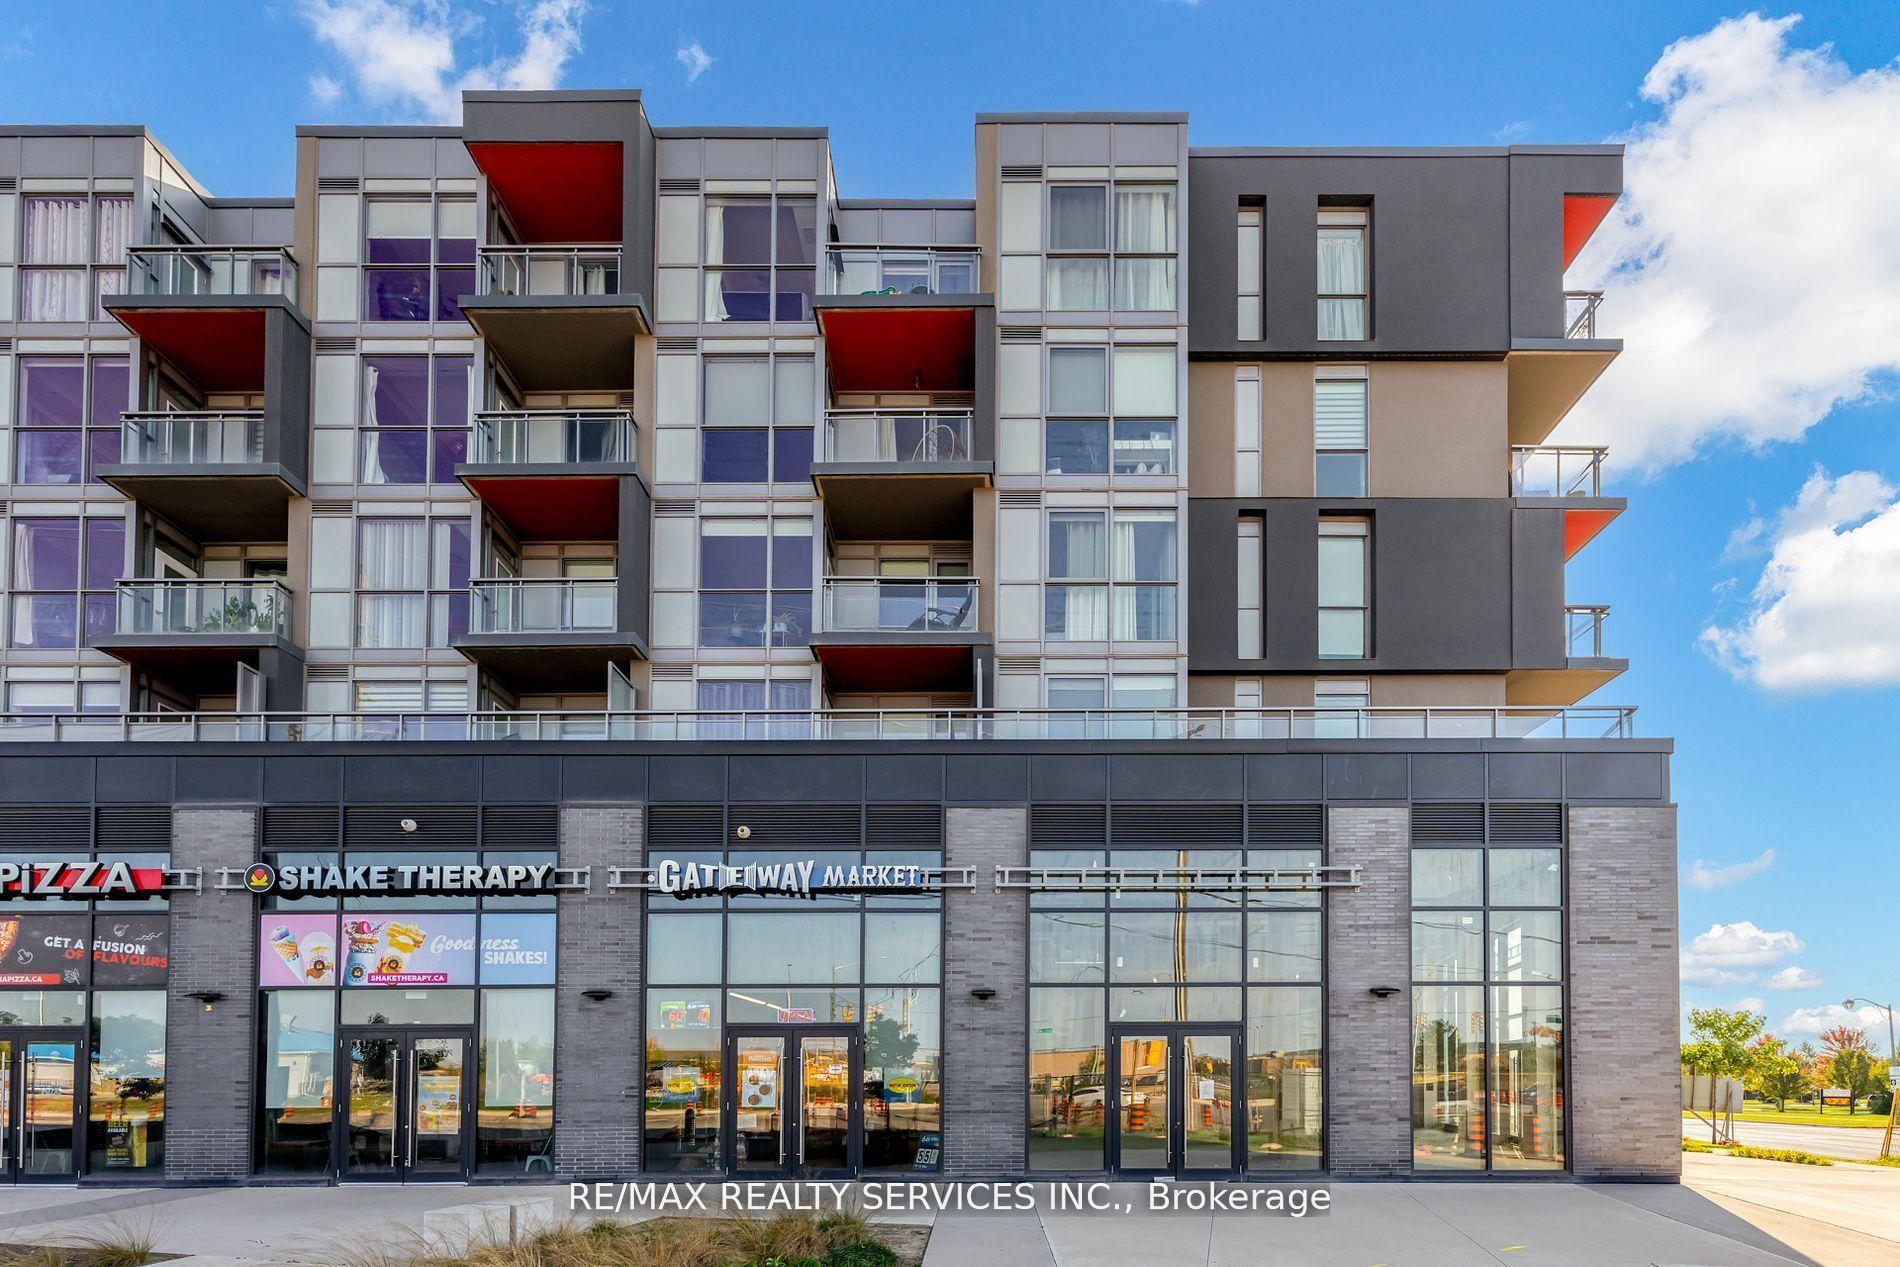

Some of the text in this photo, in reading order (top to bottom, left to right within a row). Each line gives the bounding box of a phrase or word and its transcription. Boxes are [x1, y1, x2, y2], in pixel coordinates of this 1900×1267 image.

[278, 865, 549, 890] SHAKE THERAPY
[658, 859, 920, 894] GATEWAY MARKET
[44, 935, 146, 955] GET A FUSION
[64, 948, 168, 969] OF FLAVOURS
[484, 950, 548, 965] SHAKES!
[370, 974, 445, 982] SHAKETHERAPY.CA
